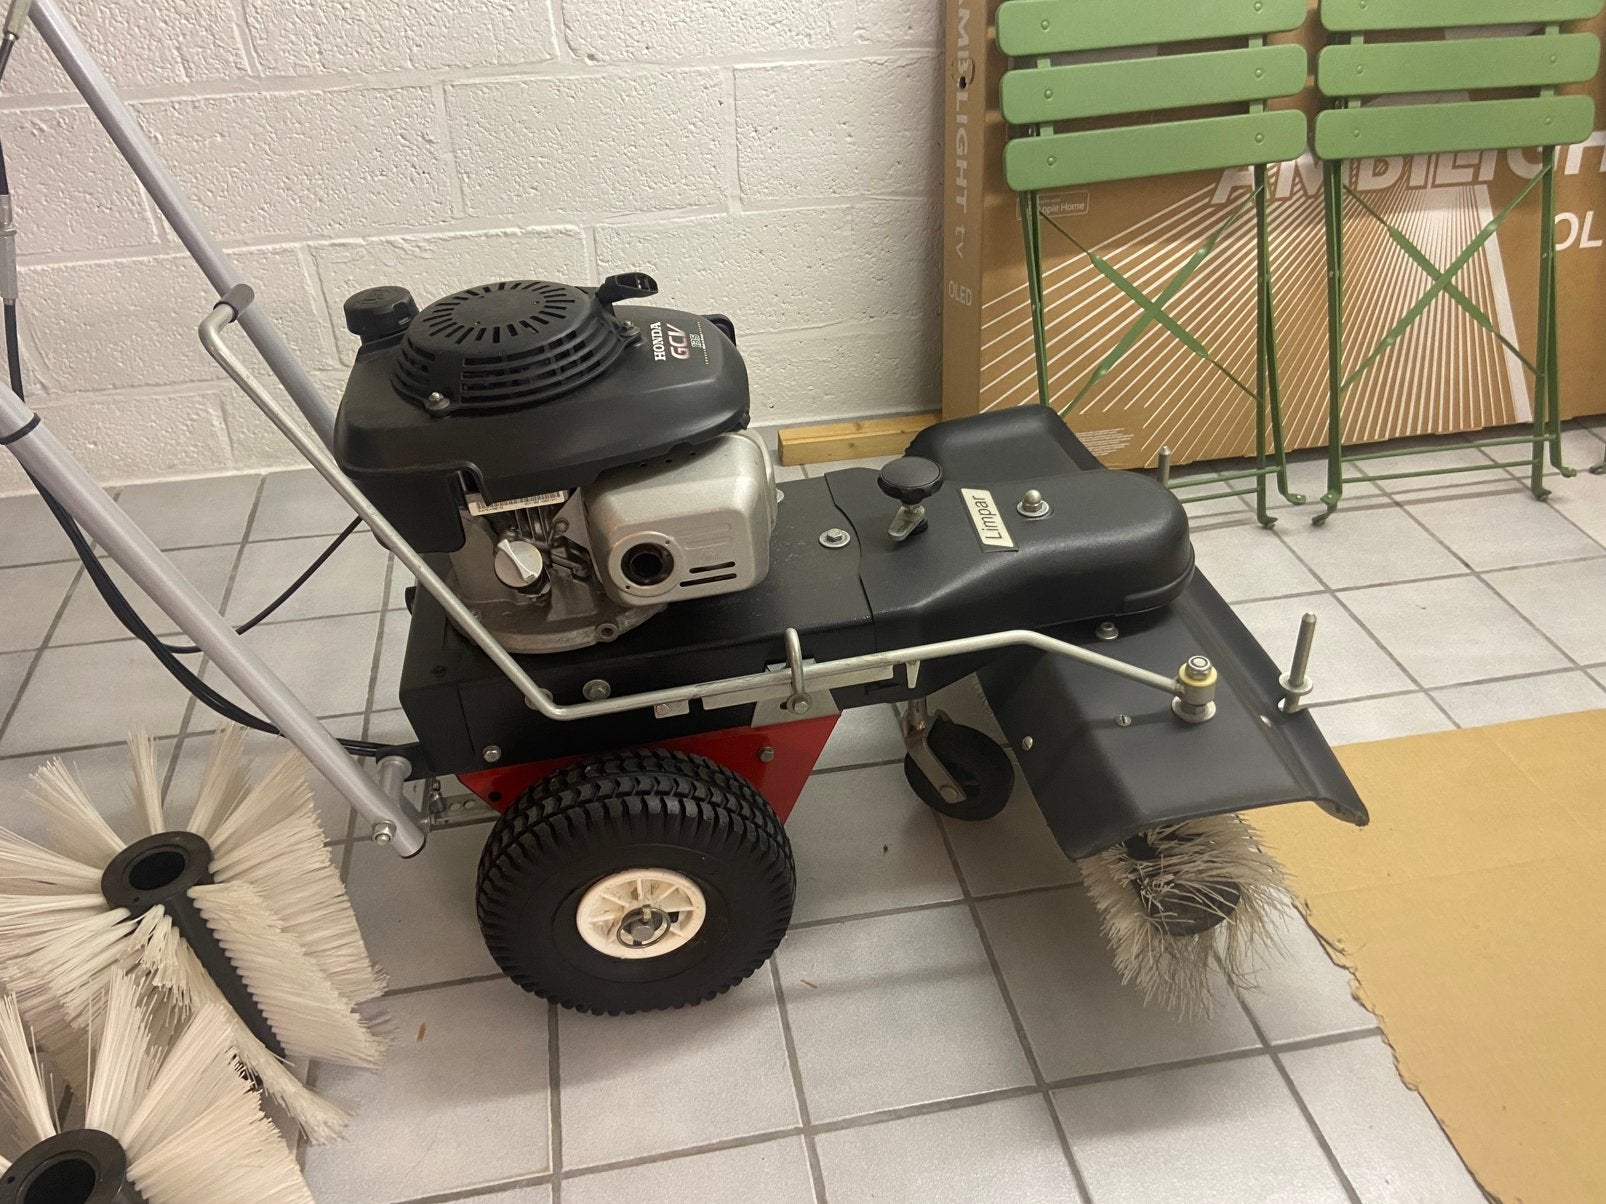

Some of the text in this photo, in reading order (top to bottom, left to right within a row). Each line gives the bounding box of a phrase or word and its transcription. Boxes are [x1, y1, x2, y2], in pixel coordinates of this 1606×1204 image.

[956, 0, 970, 214] MBLIGHT
[1060, 202, 1085, 212] Home
[948, 280, 973, 307] OLED
[650, 321, 667, 361] HONDA
[666, 323, 691, 360] GCV
[972, 495, 1003, 539] Limpar
